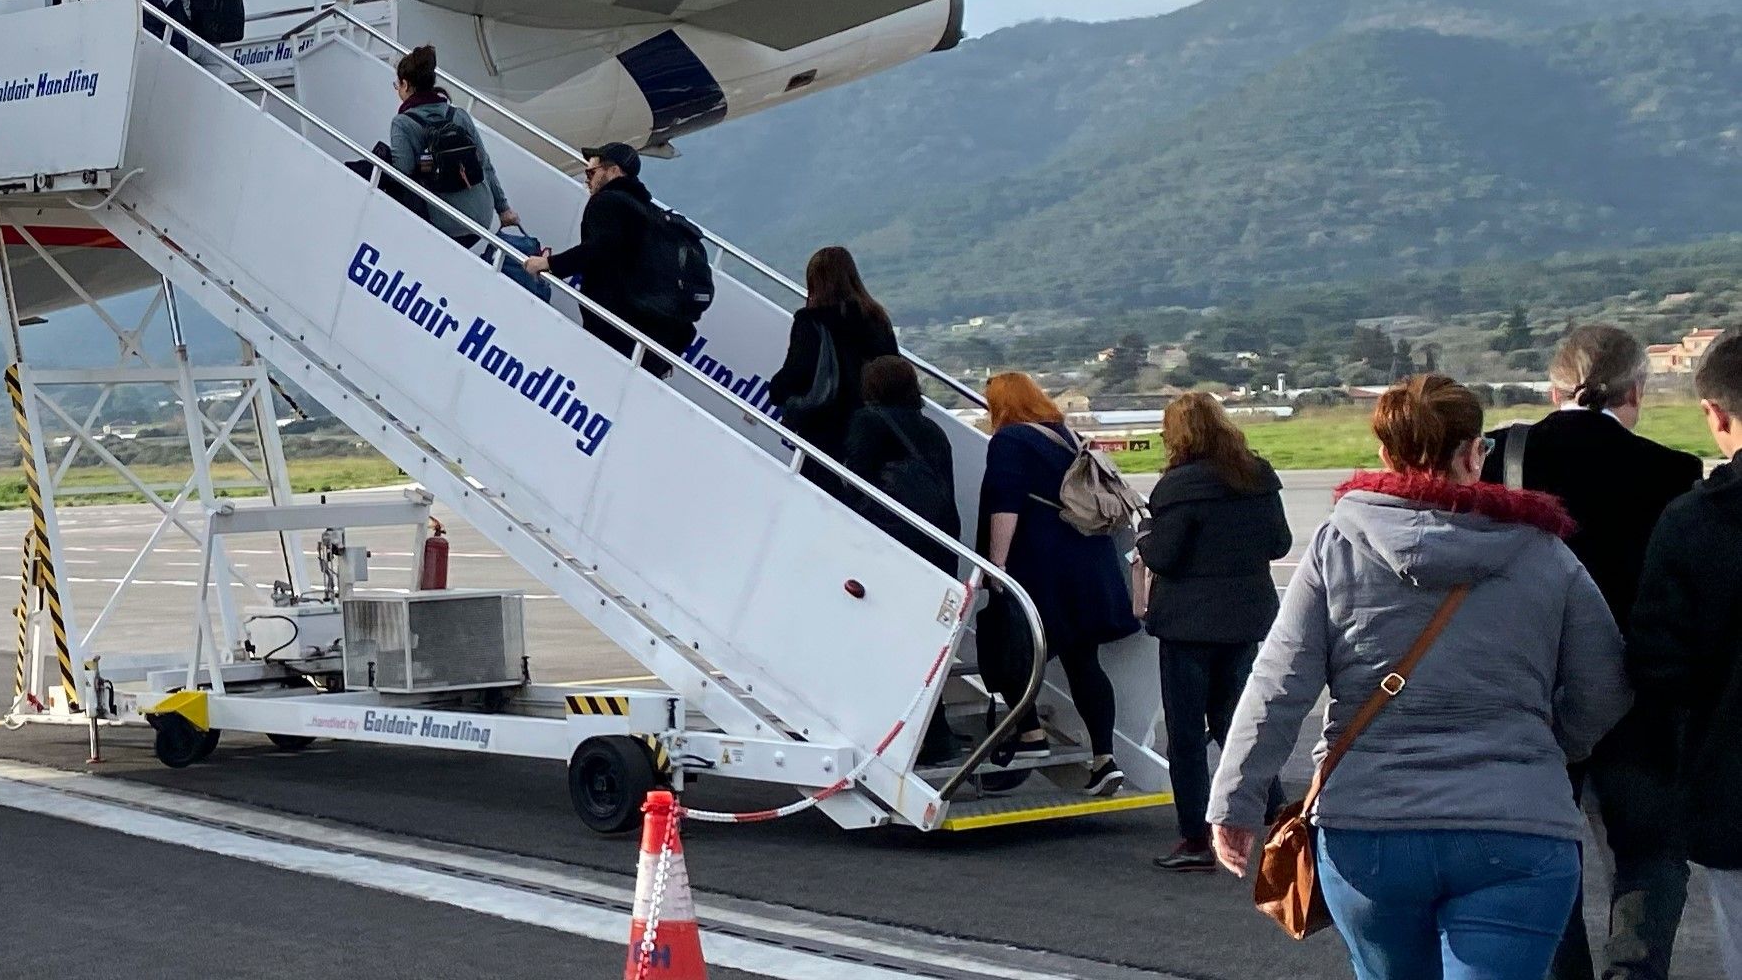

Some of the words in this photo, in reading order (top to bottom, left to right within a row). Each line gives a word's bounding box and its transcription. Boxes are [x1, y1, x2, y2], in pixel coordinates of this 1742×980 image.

[234, 45, 274, 66] Goldair
[35, 68, 99, 98] Handling
[347, 241, 459, 340] Goldair
[456, 316, 613, 457] Handling
[363, 710, 418, 736] Goldair
[420, 715, 492, 749] Handling
